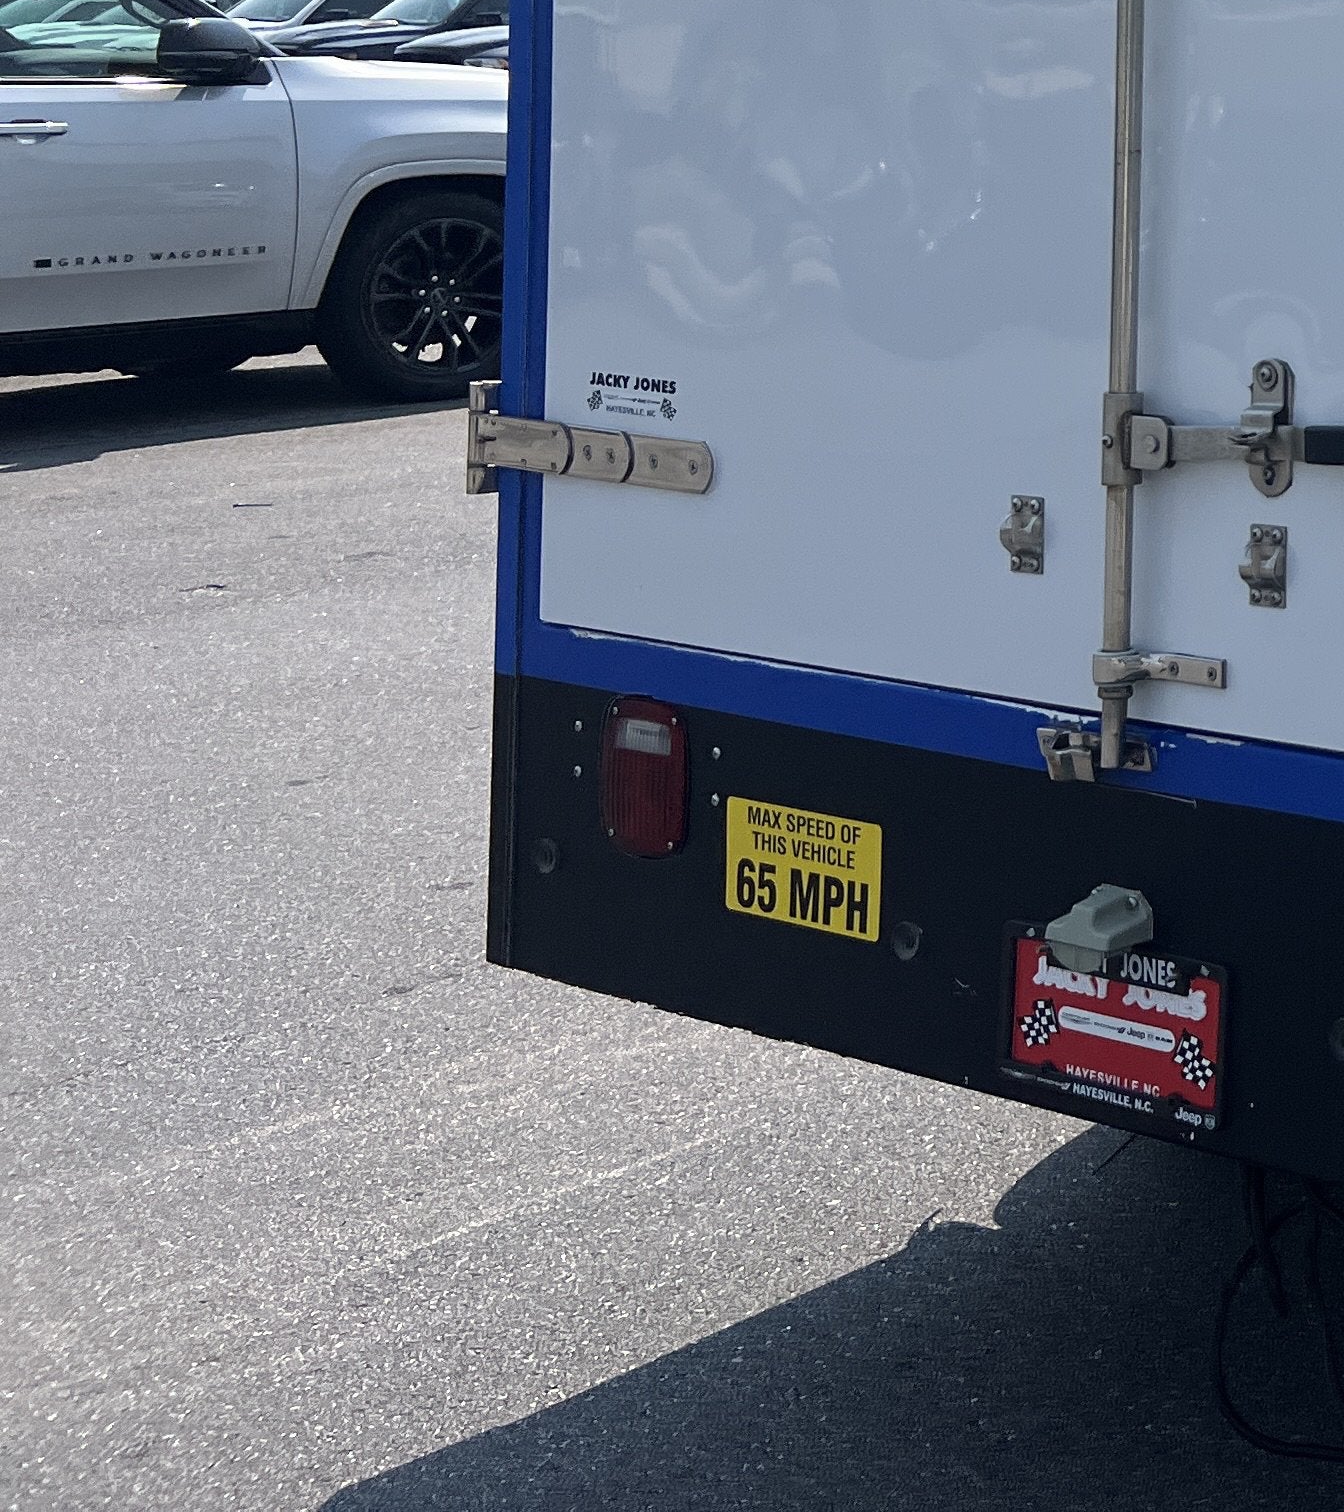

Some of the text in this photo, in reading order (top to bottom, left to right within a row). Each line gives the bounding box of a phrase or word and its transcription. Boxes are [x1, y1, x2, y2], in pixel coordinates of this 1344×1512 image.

[58, 245, 267, 267] GRAND WAGONEER
[589, 371, 677, 395] JACKY JONES
[748, 806, 862, 845] MAX SPEED OF
[752, 831, 856, 870] THIS VEHICLE
[736, 857, 869, 934] 65 MPH
[1120, 952, 1177, 989] JONES
[1174, 1106, 1203, 1127] Jeep
